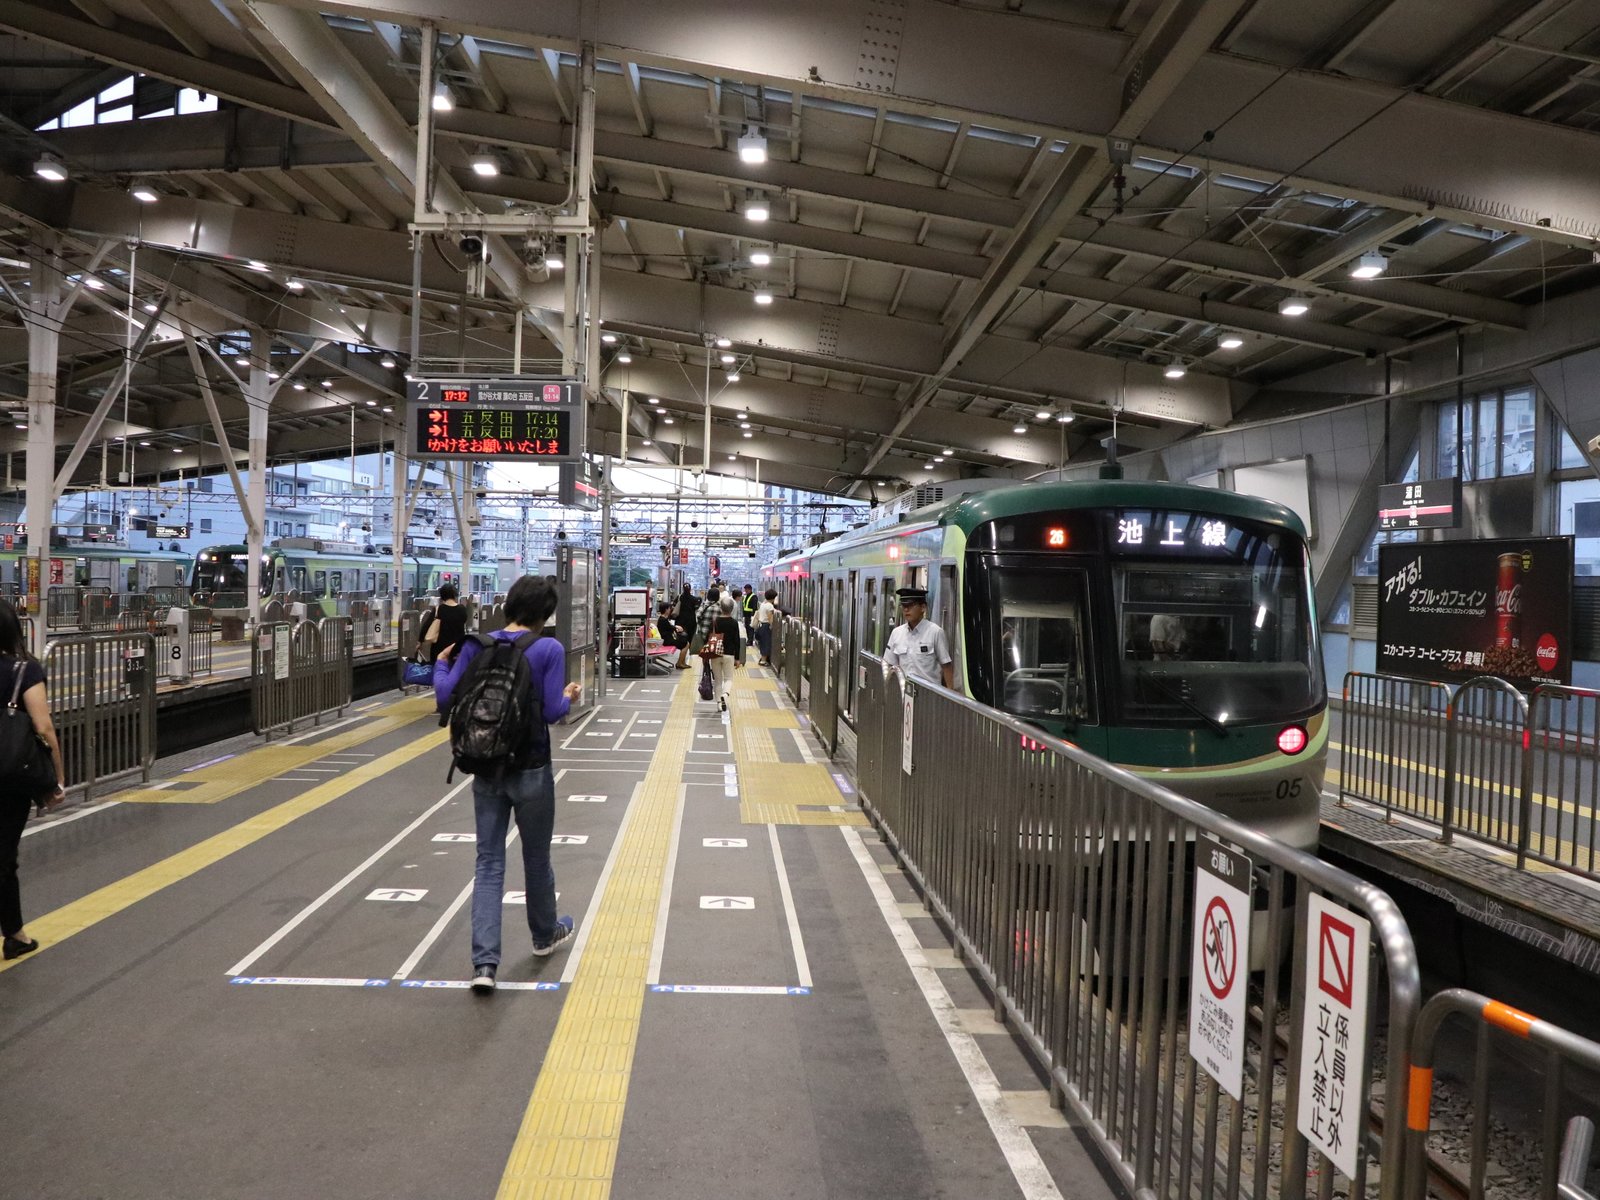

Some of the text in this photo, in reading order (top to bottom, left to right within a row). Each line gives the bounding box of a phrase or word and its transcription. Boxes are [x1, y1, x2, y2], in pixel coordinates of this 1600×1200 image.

[417, 382, 429, 400] 2
[444, 390, 468, 401] 17:12
[565, 385, 571, 403] 1
[442, 411, 558, 425] 1 五反田 17:14
[442, 426, 558, 439] 1 五反田 17:20
[428, 439, 559, 454] かけをお願いいたしま
[180, 527, 187, 536] 3
[1050, 530, 1064, 544] 26
[1118, 519, 1226, 546] 池上線
[374, 624, 381, 632] 6
[172, 646, 181, 660] 8
[1276, 778, 1302, 800] 05
[1211, 849, 1234, 876] お願い
[1310, 1002, 1331, 1141] 立入禁止
[1327, 1012, 1349, 1155] 係員以外
